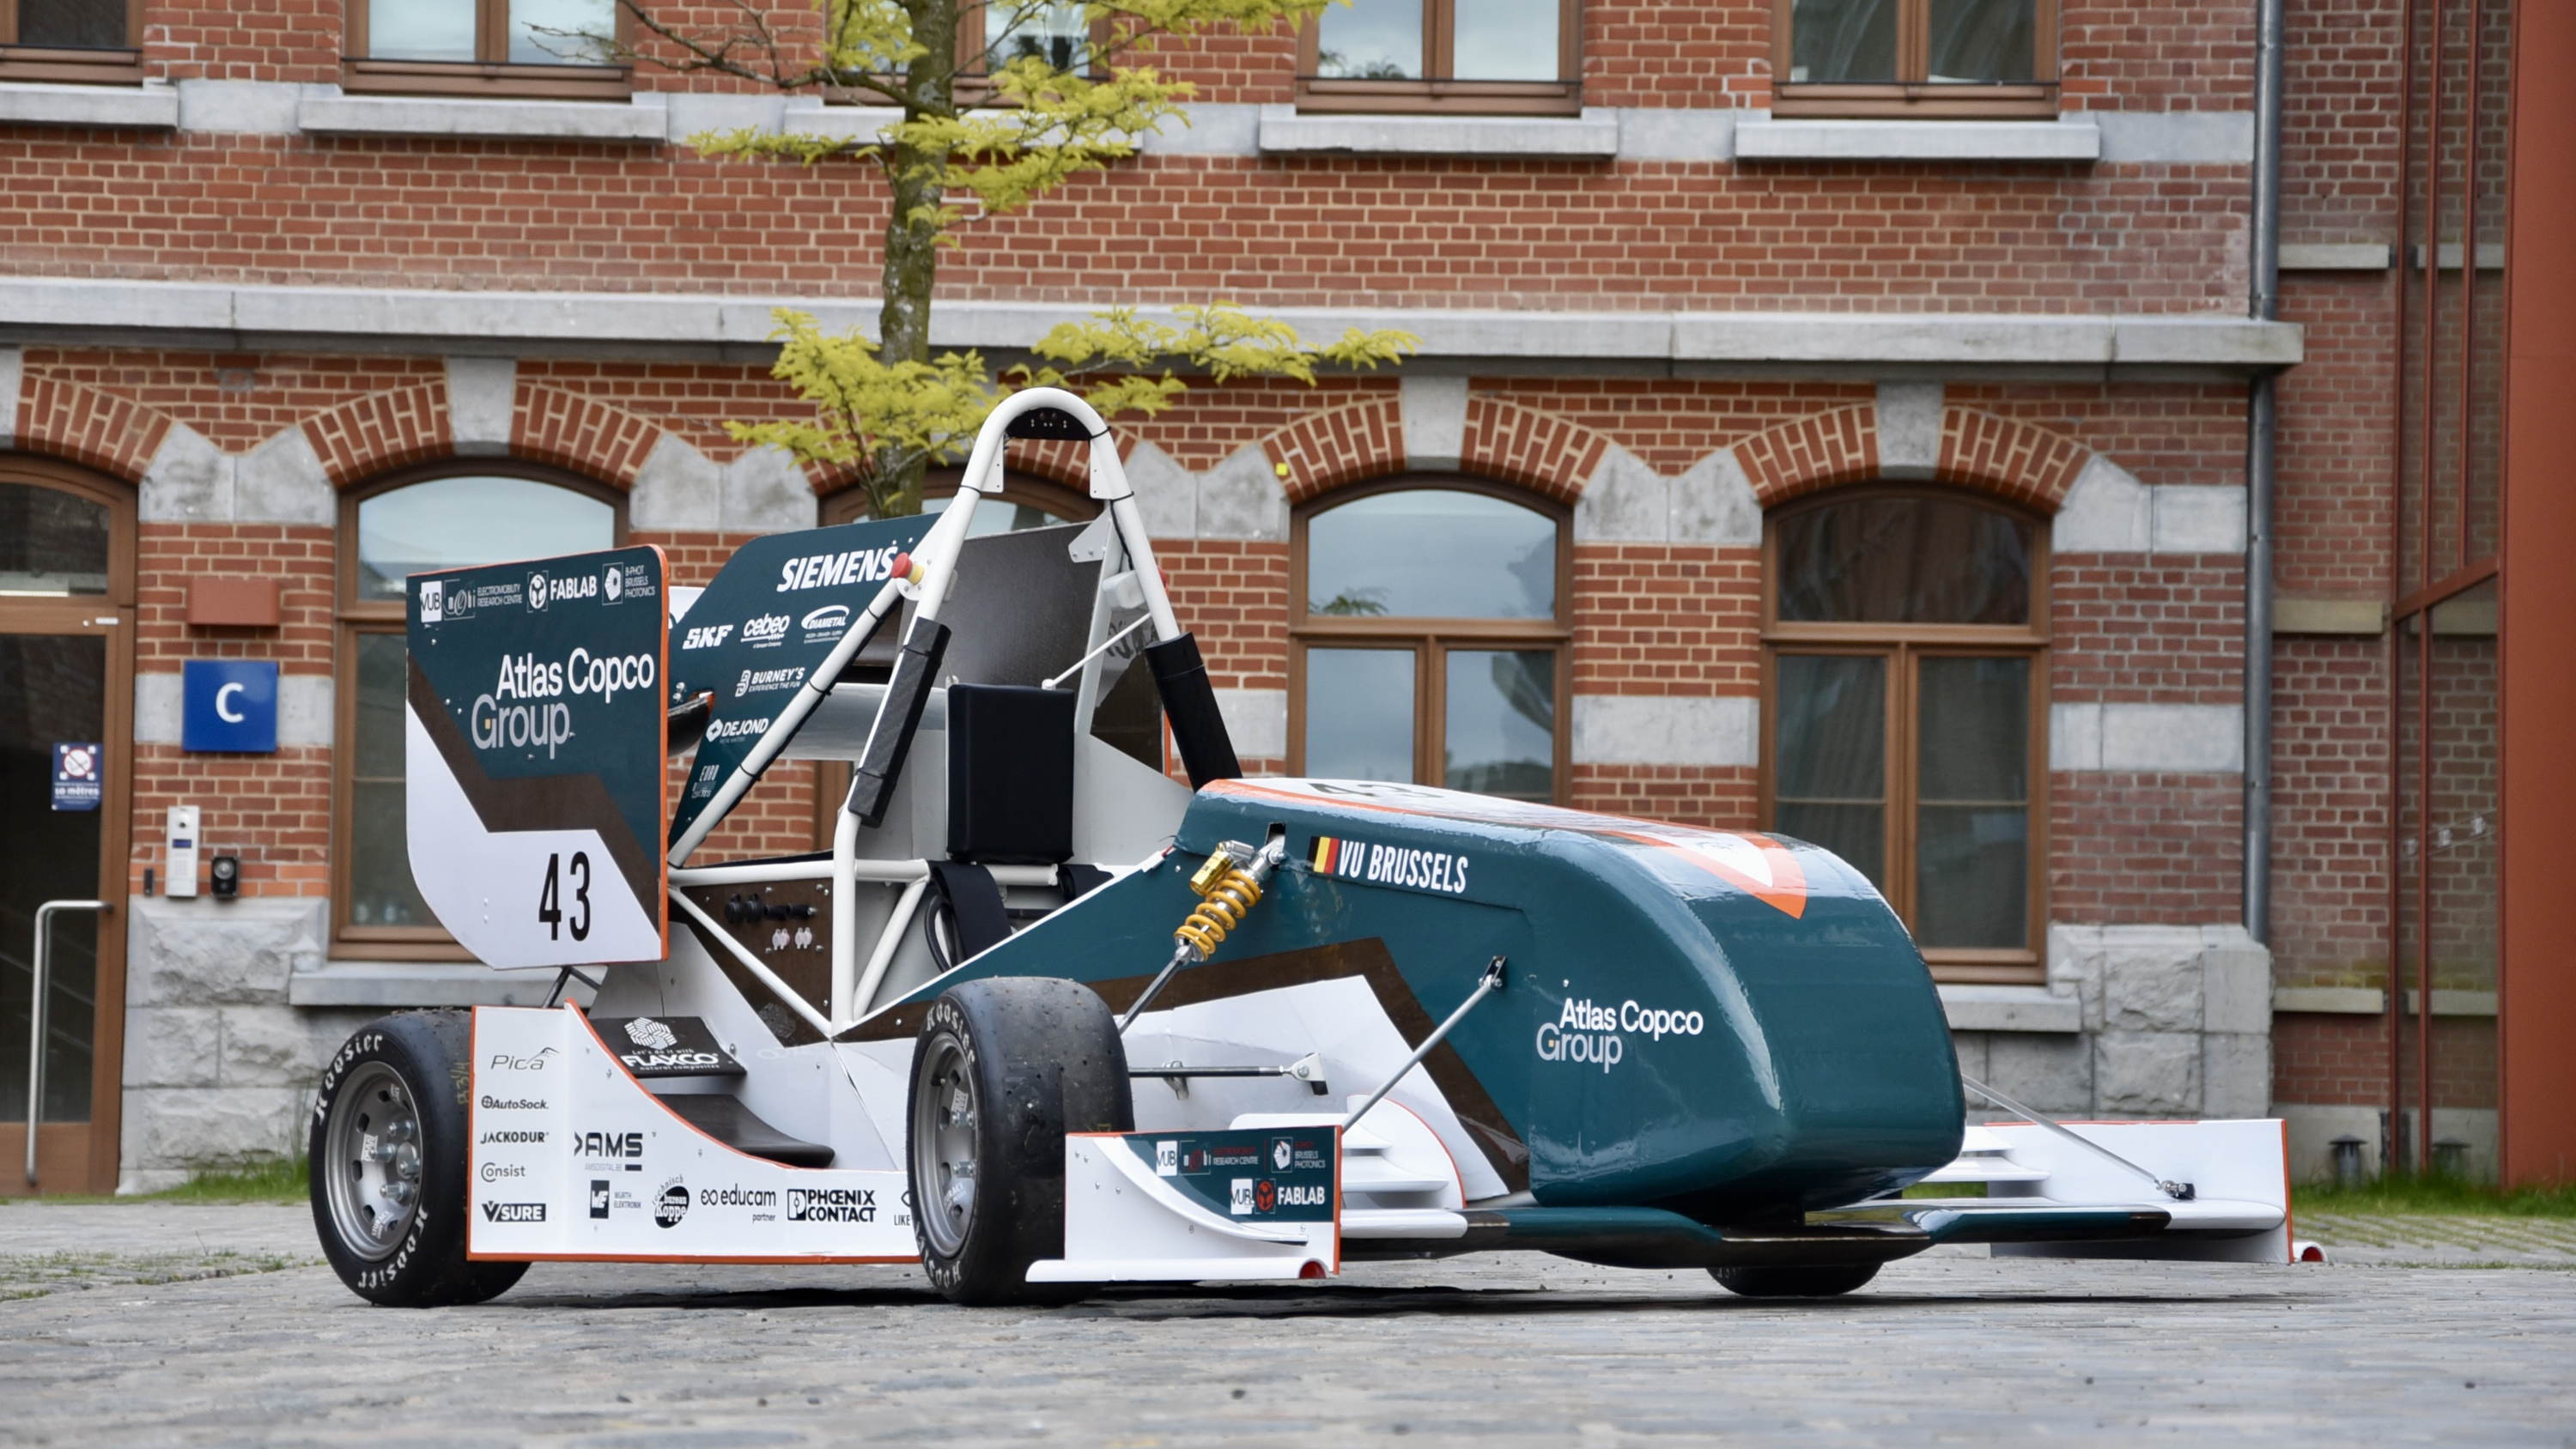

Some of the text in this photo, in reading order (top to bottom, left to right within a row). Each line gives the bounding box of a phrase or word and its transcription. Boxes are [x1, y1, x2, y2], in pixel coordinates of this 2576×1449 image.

[776, 546, 898, 592] SIEMENS
[477, 584, 521, 596] ELECTROMOBILITY
[550, 575, 597, 600] FABLAB
[625, 576, 648, 587] BRUSSELS
[477, 594, 522, 607] RESEARCH CENTRE
[625, 586, 655, 597] PHOTONICS
[420, 592, 440, 611] VUB
[744, 613, 790, 636] cebeo
[809, 616, 846, 629] DIAMETAL
[683, 625, 733, 650] SKF
[496, 647, 654, 704] Atlas Copco
[751, 667, 805, 684] BURNEY'S
[749, 683, 778, 692] EXPERIENCE
[780, 682, 789, 690] THE
[216, 682, 244, 723] C
[471, 694, 569, 759] Group
[721, 718, 769, 737] DEJOND
[1339, 840, 1468, 894] VU BRUSSELS
[538, 851, 591, 942] 43
[1559, 997, 1704, 1041] Atlas Copco
[1536, 1022, 1622, 1074] Group
[490, 1055, 544, 1070] Pica
[1157, 1150, 1176, 1167] VUB
[1212, 1156, 1239, 1166] RESEARCH
[1240, 1155, 1259, 1165] CENTRE
[1294, 1150, 1319, 1159] BRUSSELS
[1294, 1160, 1326, 1168] PHOTONICS
[481, 1161, 526, 1183] Consist
[720, 1184, 776, 1206] educam
[1278, 1186, 1325, 1205] FABLAB
[655, 1203, 687, 1222] Koppe
[752, 1213, 776, 1222] partner
[807, 1207, 877, 1222] CONTACT
[894, 1215, 911, 1226] LIKE
